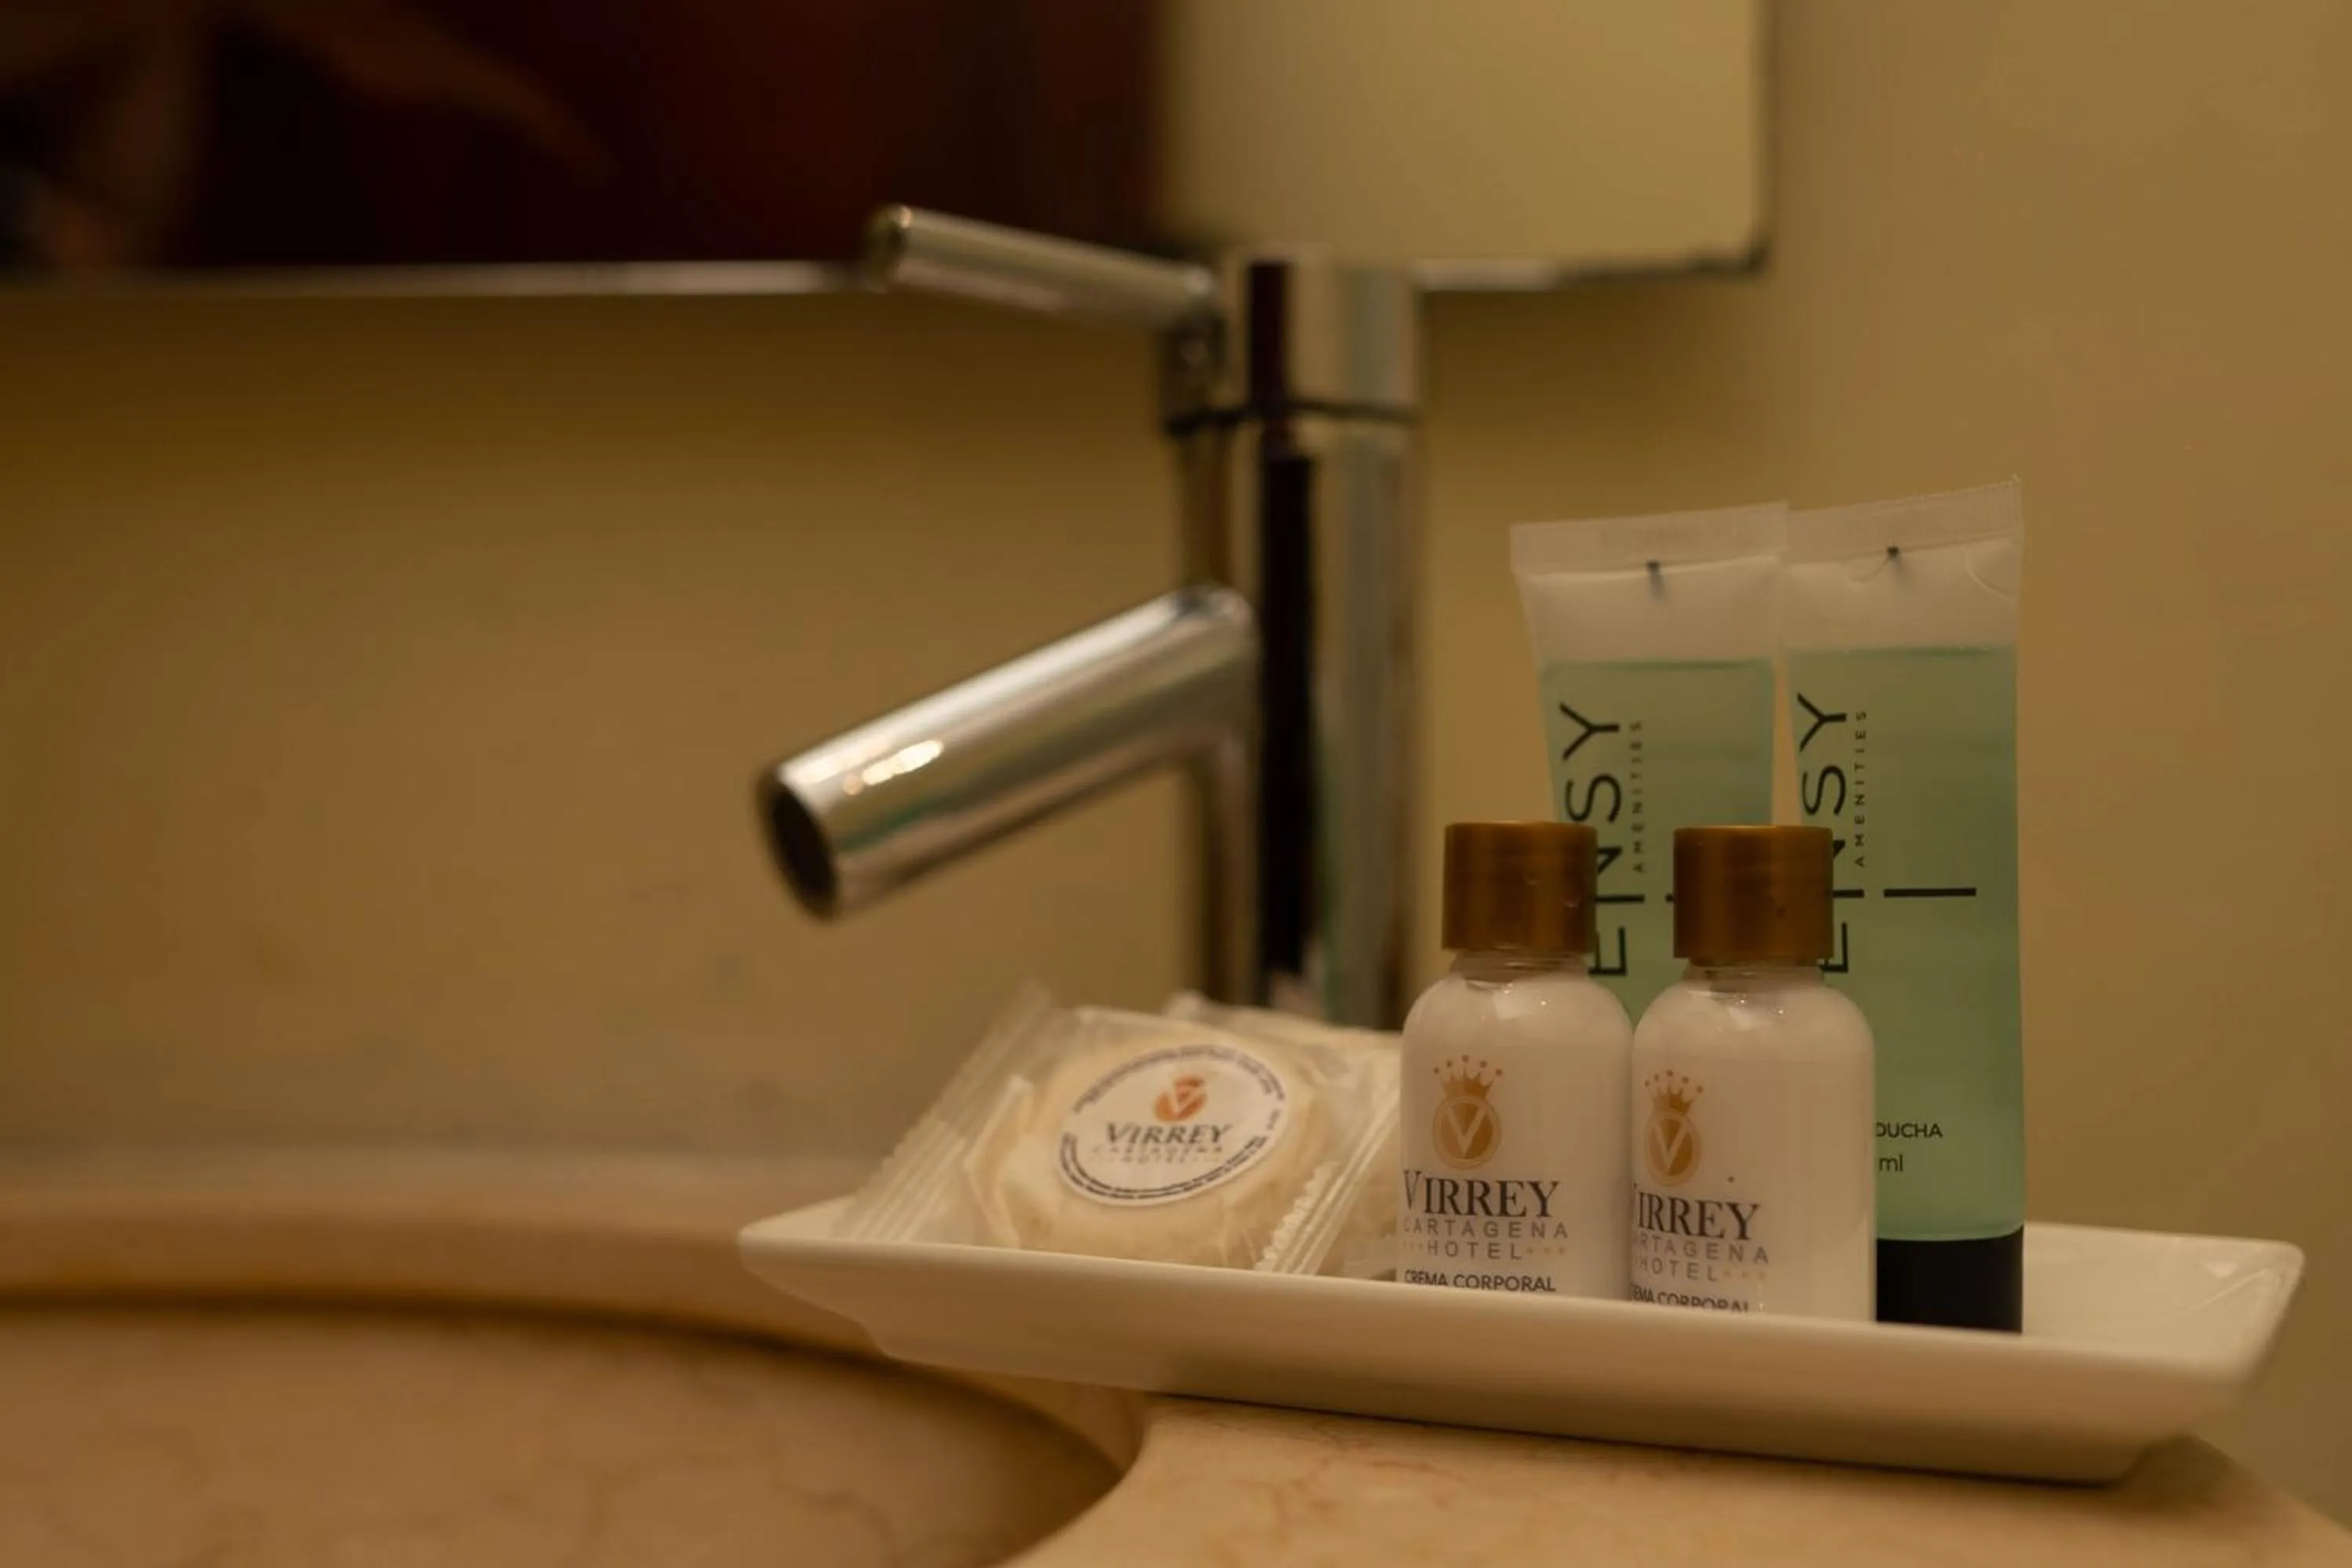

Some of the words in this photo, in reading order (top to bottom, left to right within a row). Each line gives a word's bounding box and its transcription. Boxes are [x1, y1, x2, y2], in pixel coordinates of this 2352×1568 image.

[1631, 720, 1644, 873] AMENITIES
[1854, 710, 1867, 867] AMENITIES
[1106, 1122, 1233, 1145] VIRREY
[1878, 1153, 1904, 1172] ml
[1403, 1169, 1561, 1218] VIRREY
[1633, 1182, 1761, 1242] IRREY
[1403, 1217, 1569, 1240] CARTAGENA
[1427, 1240, 1522, 1261] HOTEL
[1404, 1269, 1449, 1287] CREMA
[1453, 1273, 1556, 1293] CORPORAL
